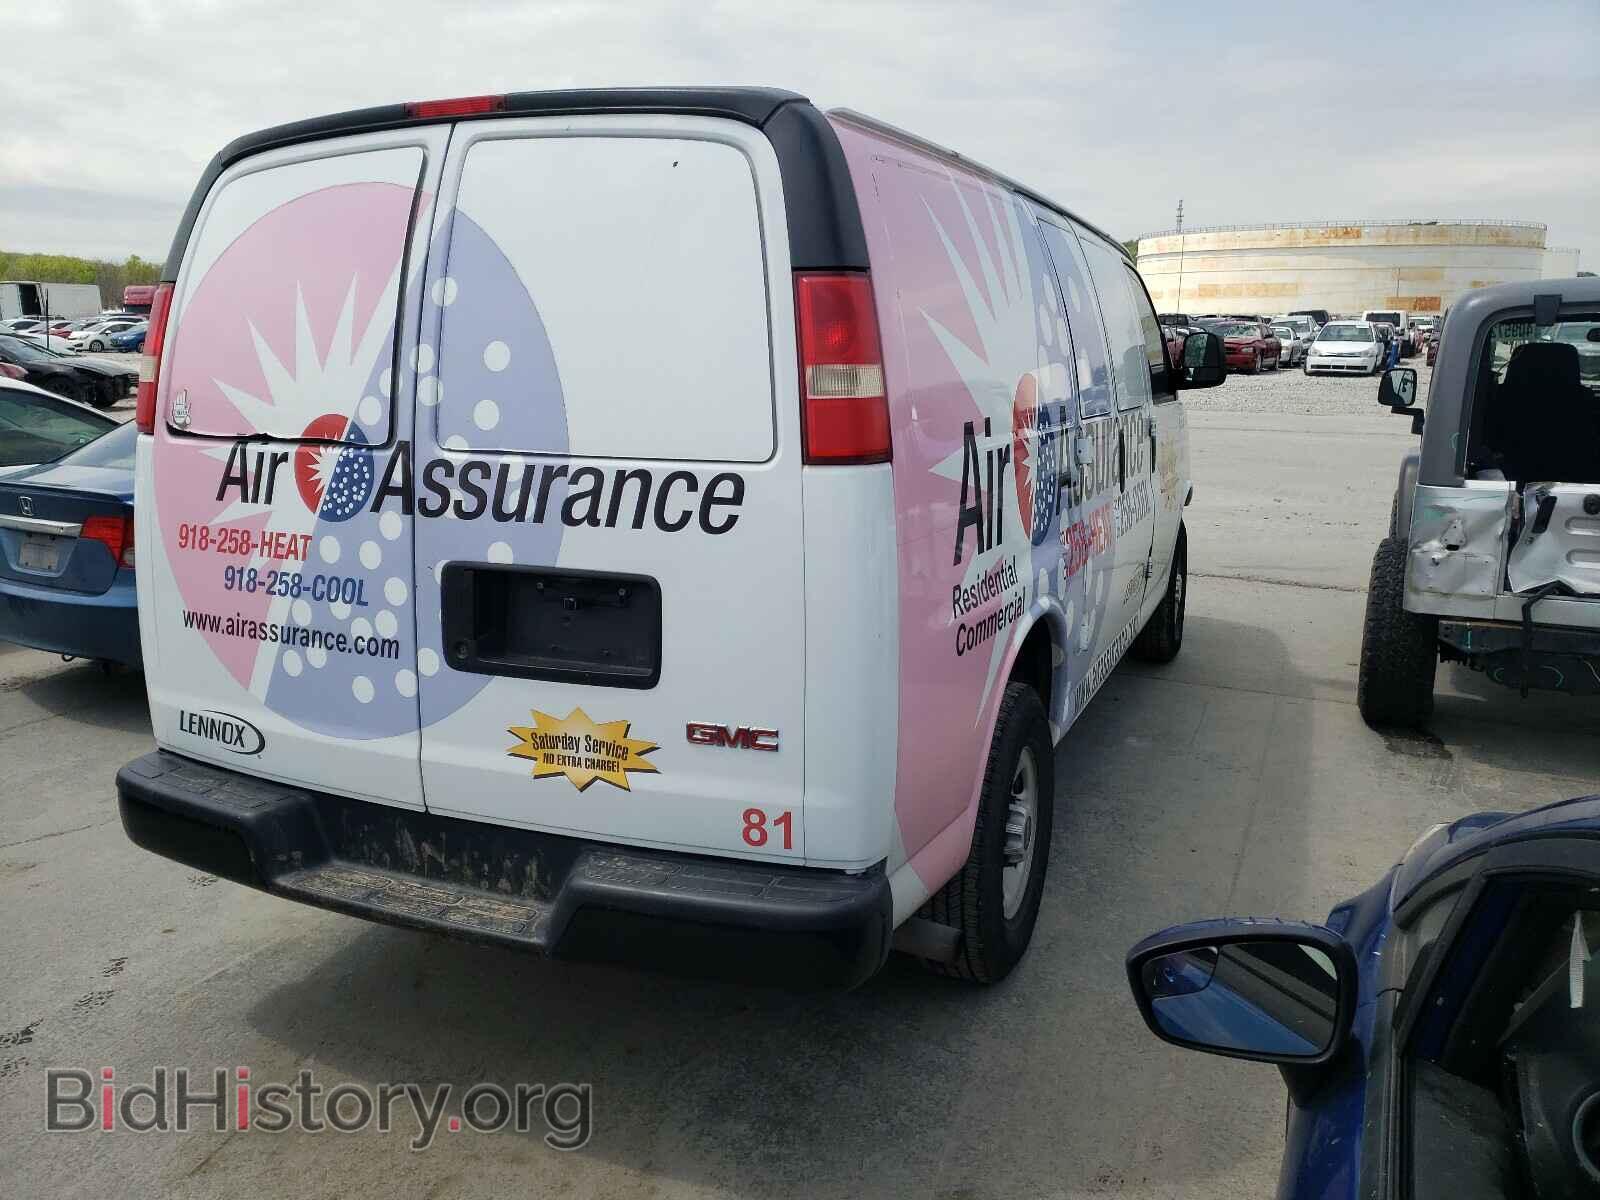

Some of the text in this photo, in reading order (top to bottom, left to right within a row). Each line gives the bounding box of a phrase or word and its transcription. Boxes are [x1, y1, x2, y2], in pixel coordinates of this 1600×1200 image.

[216, 433, 745, 535] Air Assurance
[953, 417, 1010, 567] Air
[178, 523, 313, 561] 918-258-HEAT
[224, 566, 369, 607] 918-258-COOL
[952, 555, 1018, 619] Residential
[183, 609, 400, 660] www.airassurance.com
[956, 586, 1026, 656] Commercial
[180, 710, 246, 748] LENNOX
[530, 732, 629, 761] Saturday Service
[686, 720, 780, 753] GMC
[542, 752, 620, 773] NO EXTRA CHARGE!
[742, 807, 793, 850] 81
